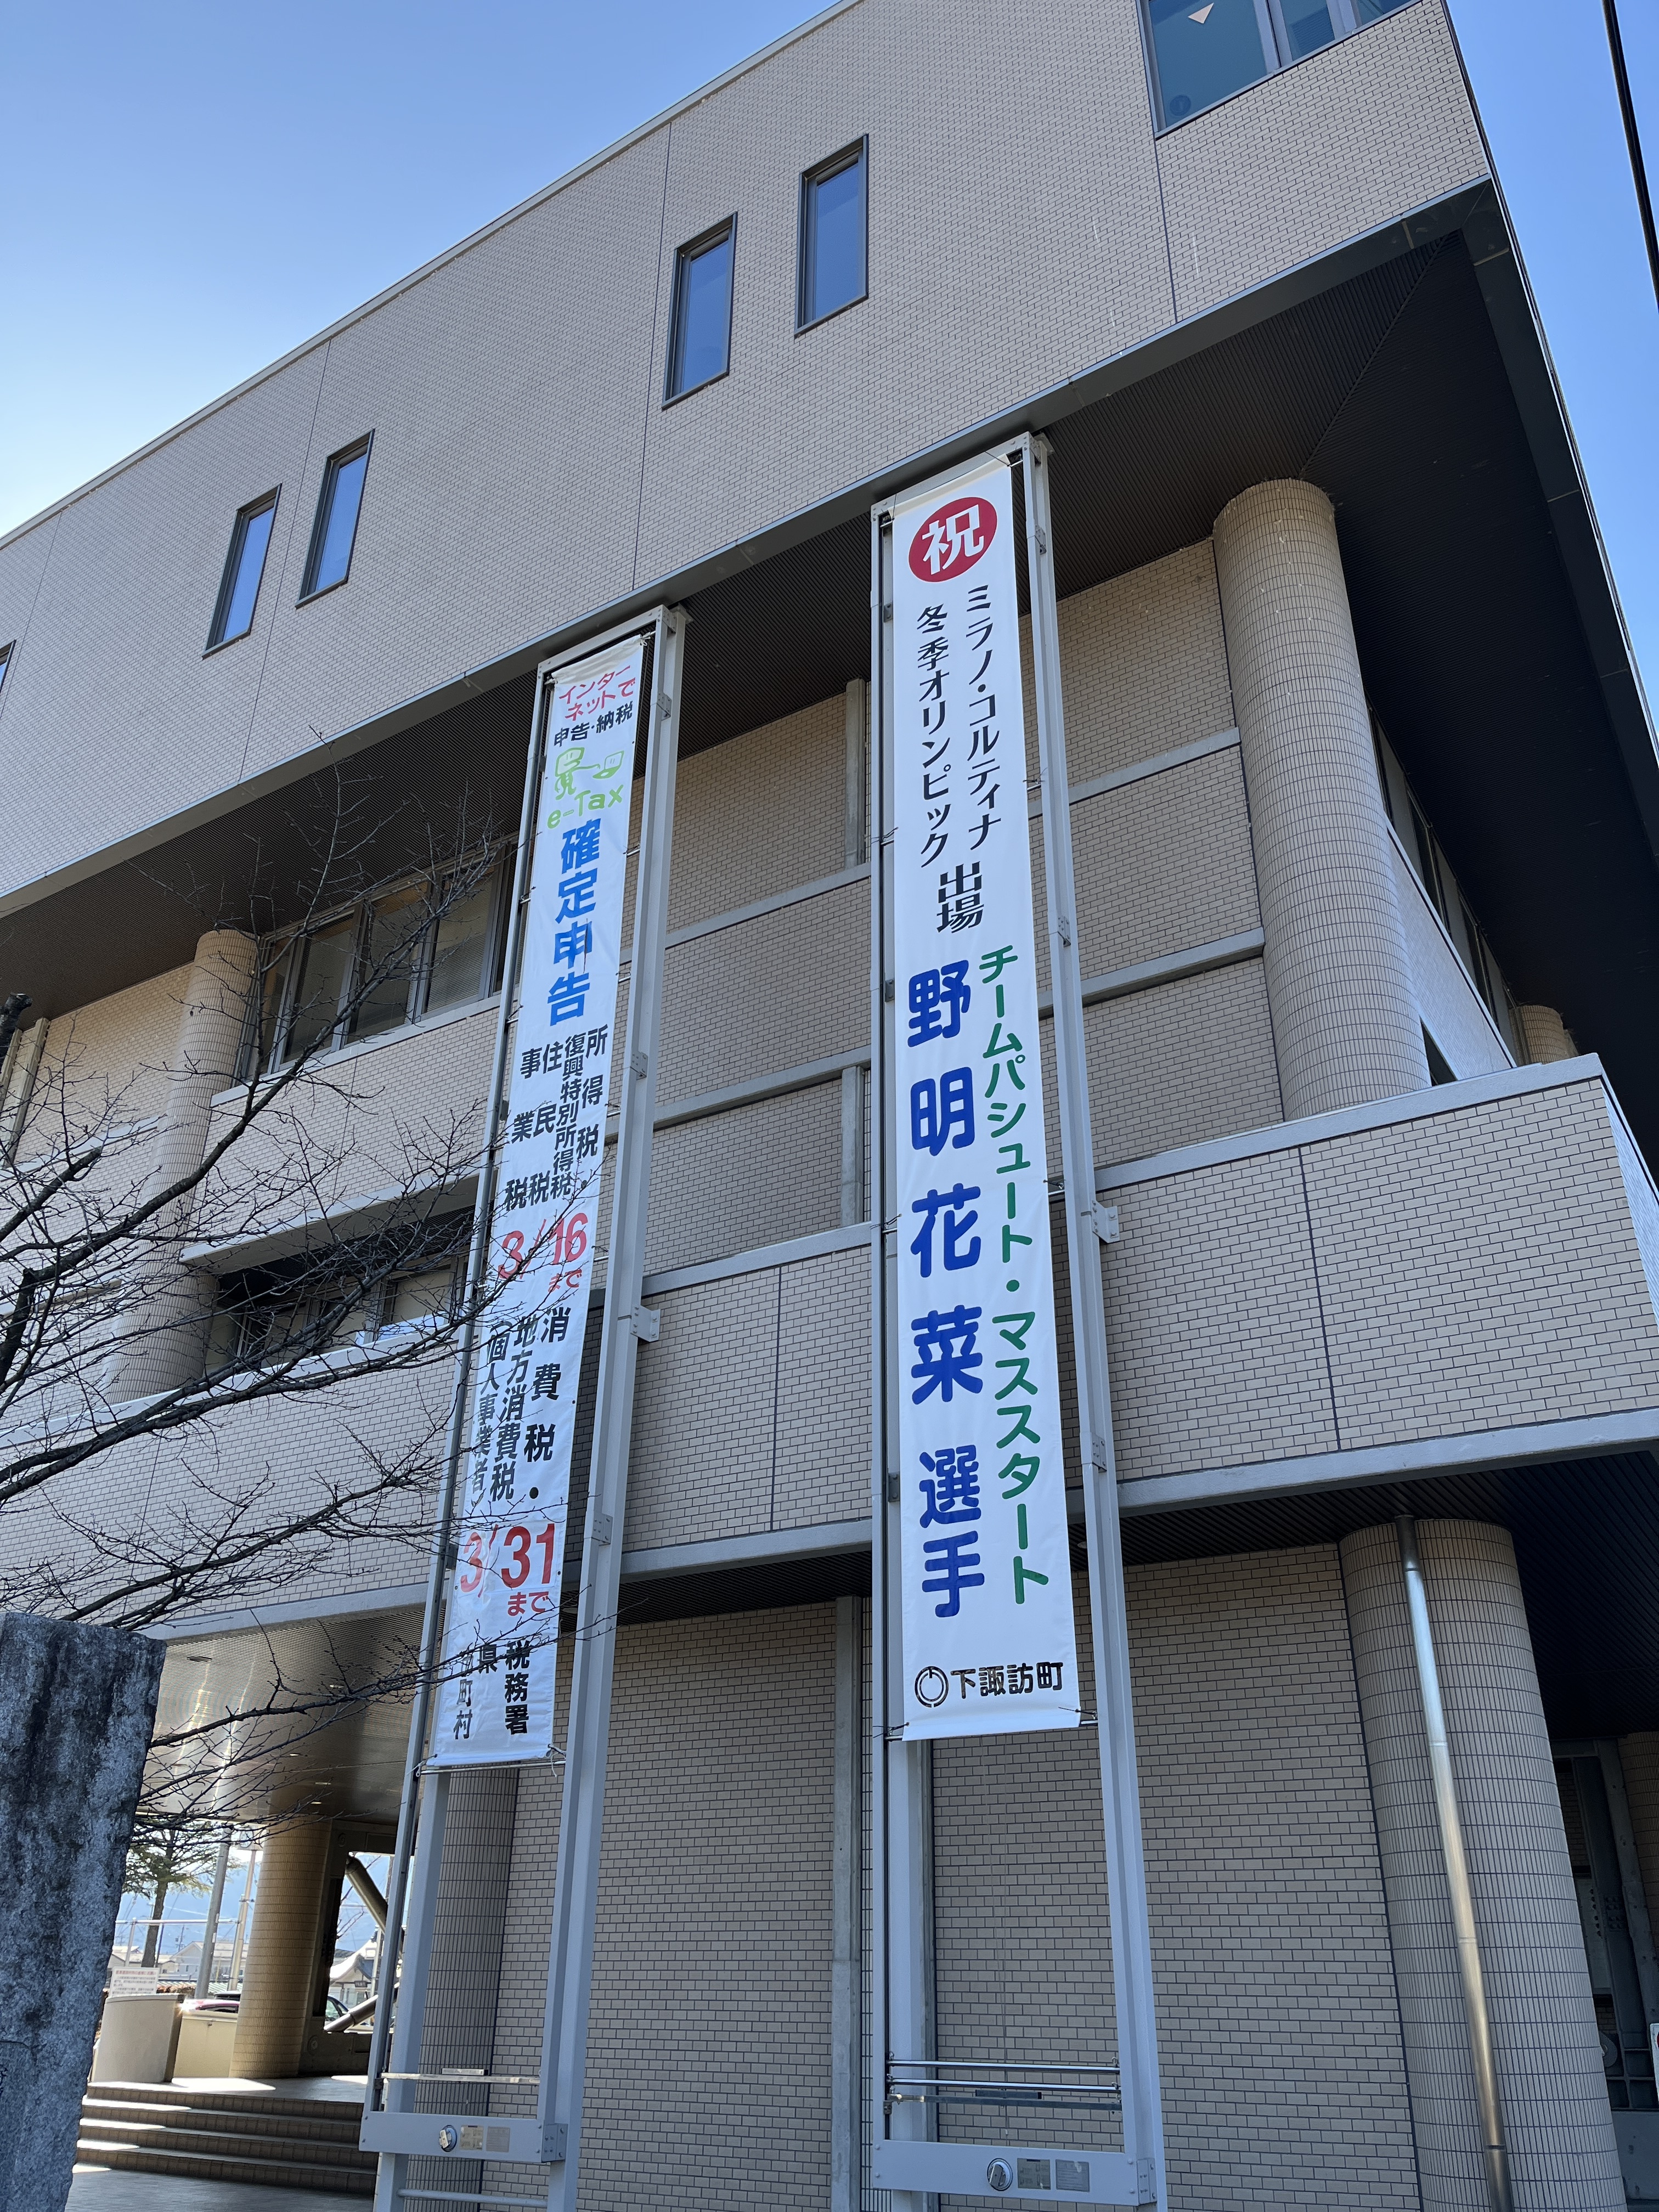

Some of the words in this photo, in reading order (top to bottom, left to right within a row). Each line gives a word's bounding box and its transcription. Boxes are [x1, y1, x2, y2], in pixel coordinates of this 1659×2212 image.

[922, 503, 985, 575] 祝
[558, 664, 631, 704] インター
[565, 679, 636, 721] ネットで
[966, 584, 1001, 851] ミラノ・コルティナ
[554, 701, 634, 747] 申告・納税
[917, 603, 951, 868] 冬季オリンピック
[547, 783, 624, 830] e-Tax
[547, 817, 602, 1026] 確定申告
[936, 861, 984, 934] 出場
[550, 1031, 587, 1199] 復興特別所得税
[576, 1024, 608, 1159] 所得税
[498, 1212, 588, 1280] 3/16
[548, 1268, 583, 1293] まで
[979, 945, 1049, 1605] チームパシュート・マススタート
[907, 960, 985, 1618] 野明花菜選手
[490, 1315, 539, 1502] 地方消費税
[460, 1523, 555, 1599] 3/31
[507, 1591, 549, 1616] まで
[504, 1639, 531, 1735] 税務署
[950, 1661, 1064, 1699] 下諏訪町
